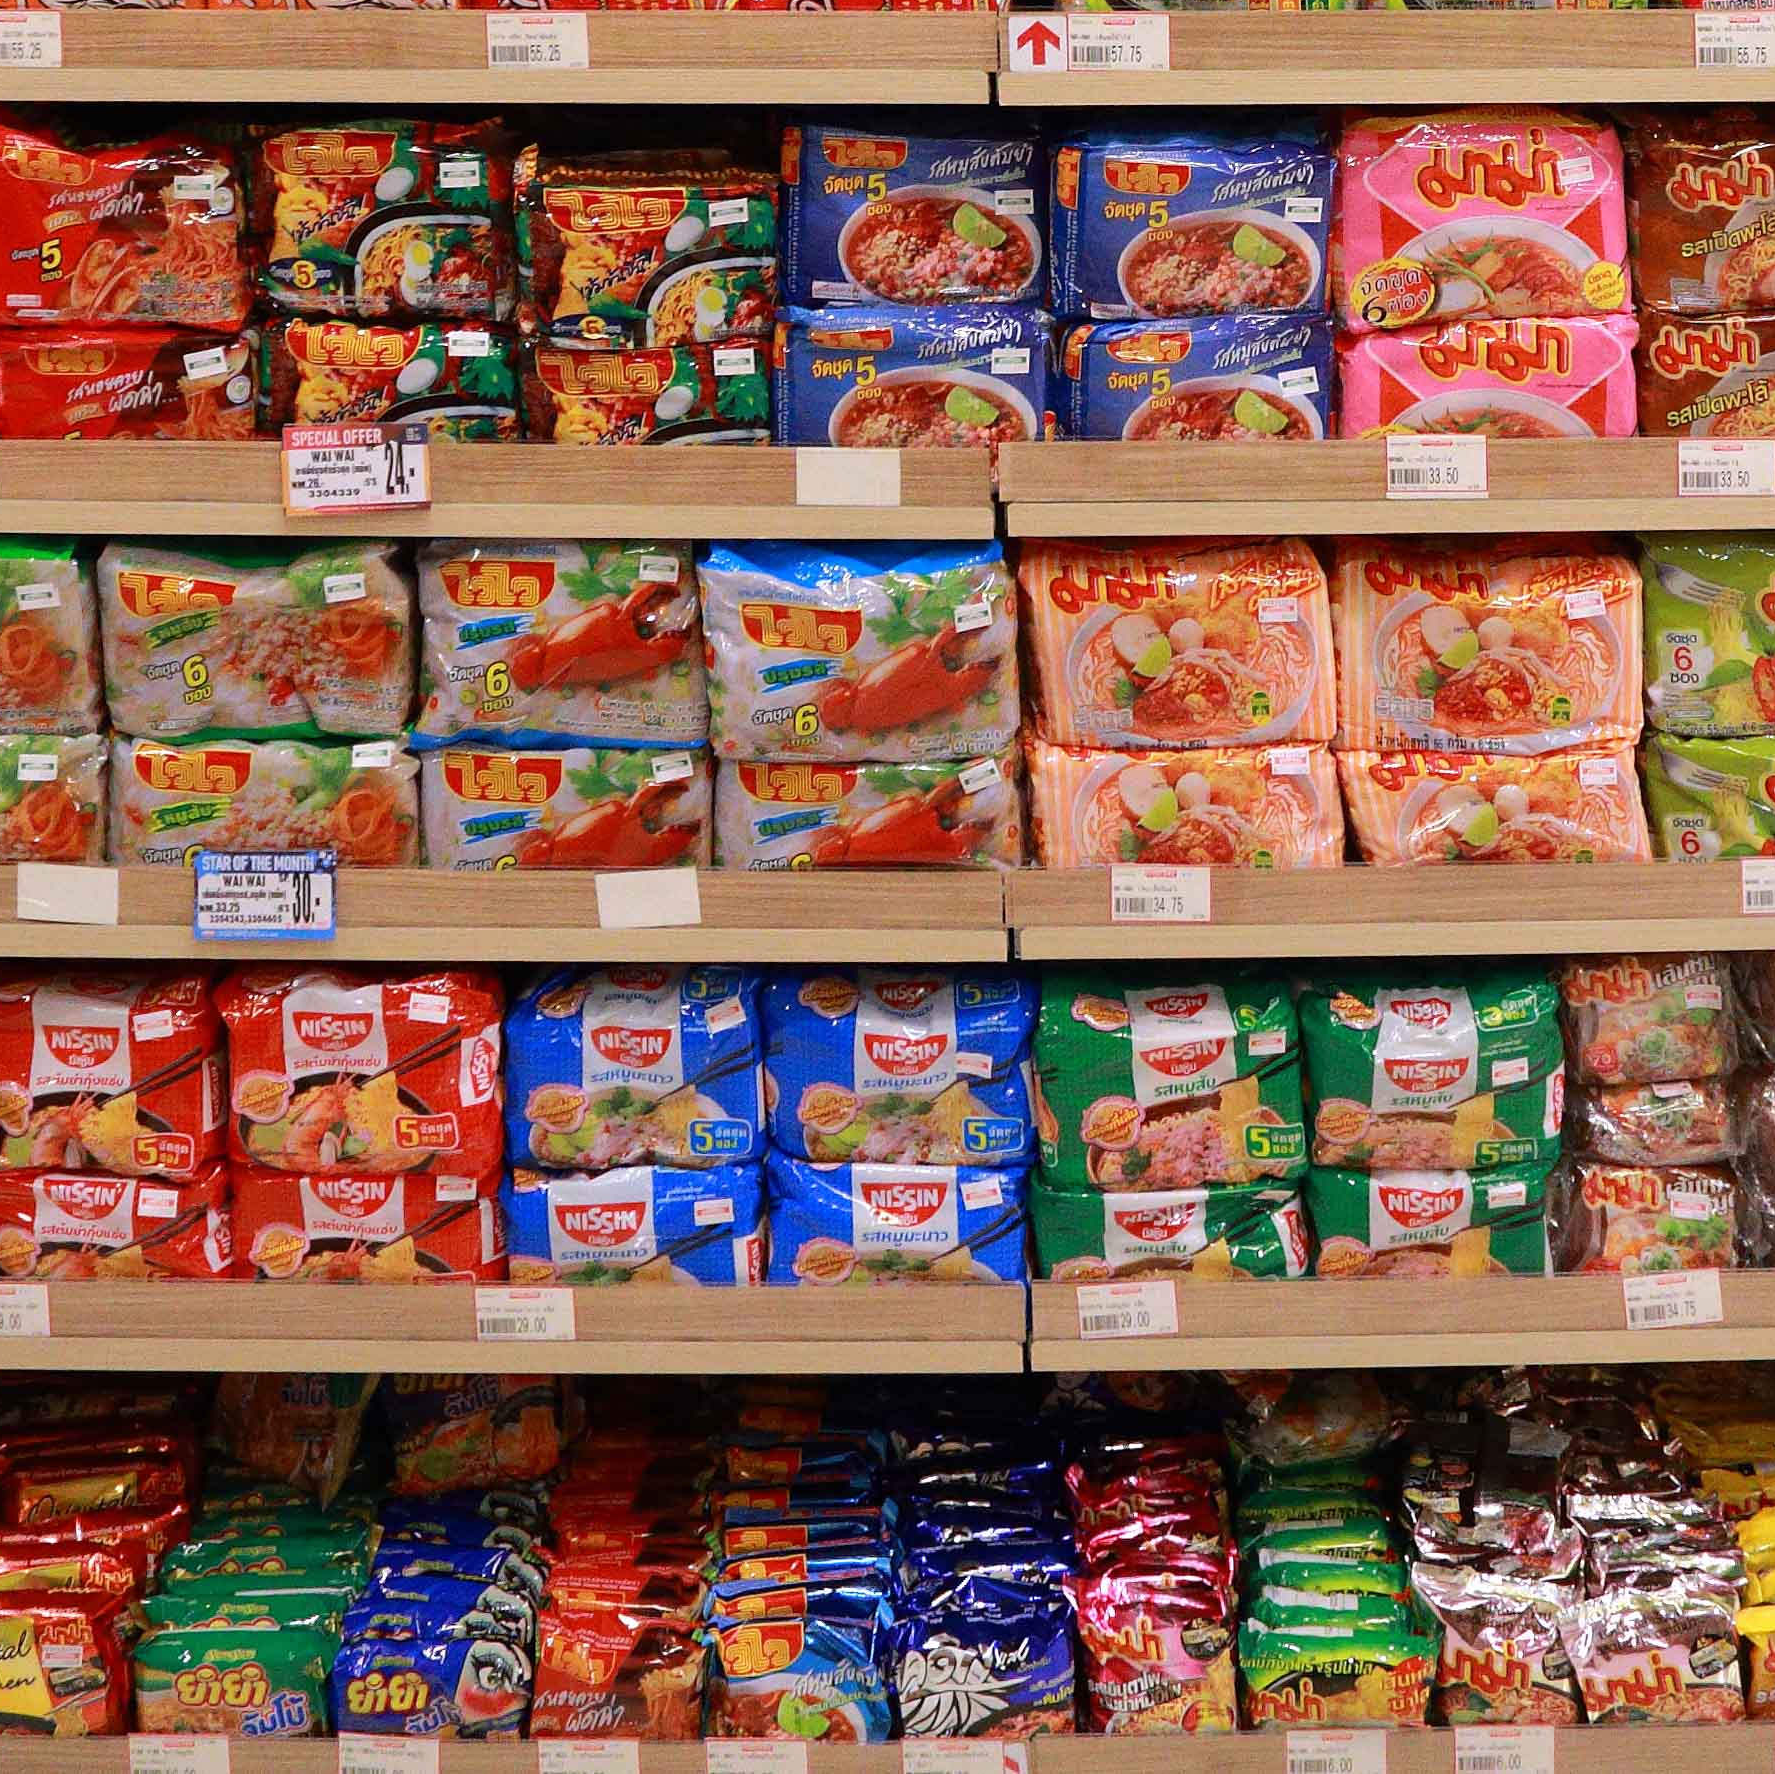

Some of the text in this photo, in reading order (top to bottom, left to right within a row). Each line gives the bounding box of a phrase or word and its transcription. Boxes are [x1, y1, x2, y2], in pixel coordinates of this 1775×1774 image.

[12, 42, 42, 59] 55.25
[530, 43, 561, 62] 55.25
[1110, 44, 1142, 63] 57.75
[1736, 45, 1767, 64] 55.75
[867, 173, 887, 202] 5
[1668, 153, 1773, 208] มาม่า
[1148, 200, 1168, 229] 5
[291, 429, 382, 447] SPECIAL OFFER
[311, 450, 355, 462] WAI WAI
[1428, 466, 1459, 485] 33.50
[1720, 471, 1750, 489] 33.50
[183, 656, 207, 687] 6
[485, 661, 509, 694] 6
[202, 856, 314, 871] STAR OF THE MONTH
[224, 876, 266, 887] WAI WAI
[1152, 895, 1184, 915] 34.75
[300, 1015, 367, 1040] NISSIN
[51, 1026, 114, 1054] NISSIN
[599, 1029, 663, 1054] NISSIN
[1148, 1040, 1220, 1064] NISSIN
[1390, 1063, 1462, 1085] NISSIN
[136, 1140, 158, 1167] 5
[44, 1180, 122, 1206] NISSIN
[317, 1180, 386, 1203] NISSIN
[867, 1187, 939, 1210] NISSIN
[1386, 1190, 1457, 1213] NISSIN
[1120, 1311, 1150, 1328] 29.00
[1665, 1302, 1697, 1320] 34.75
[516, 1316, 547, 1333] 29.00
[1329, 1756, 1353, 1773] 6.00
